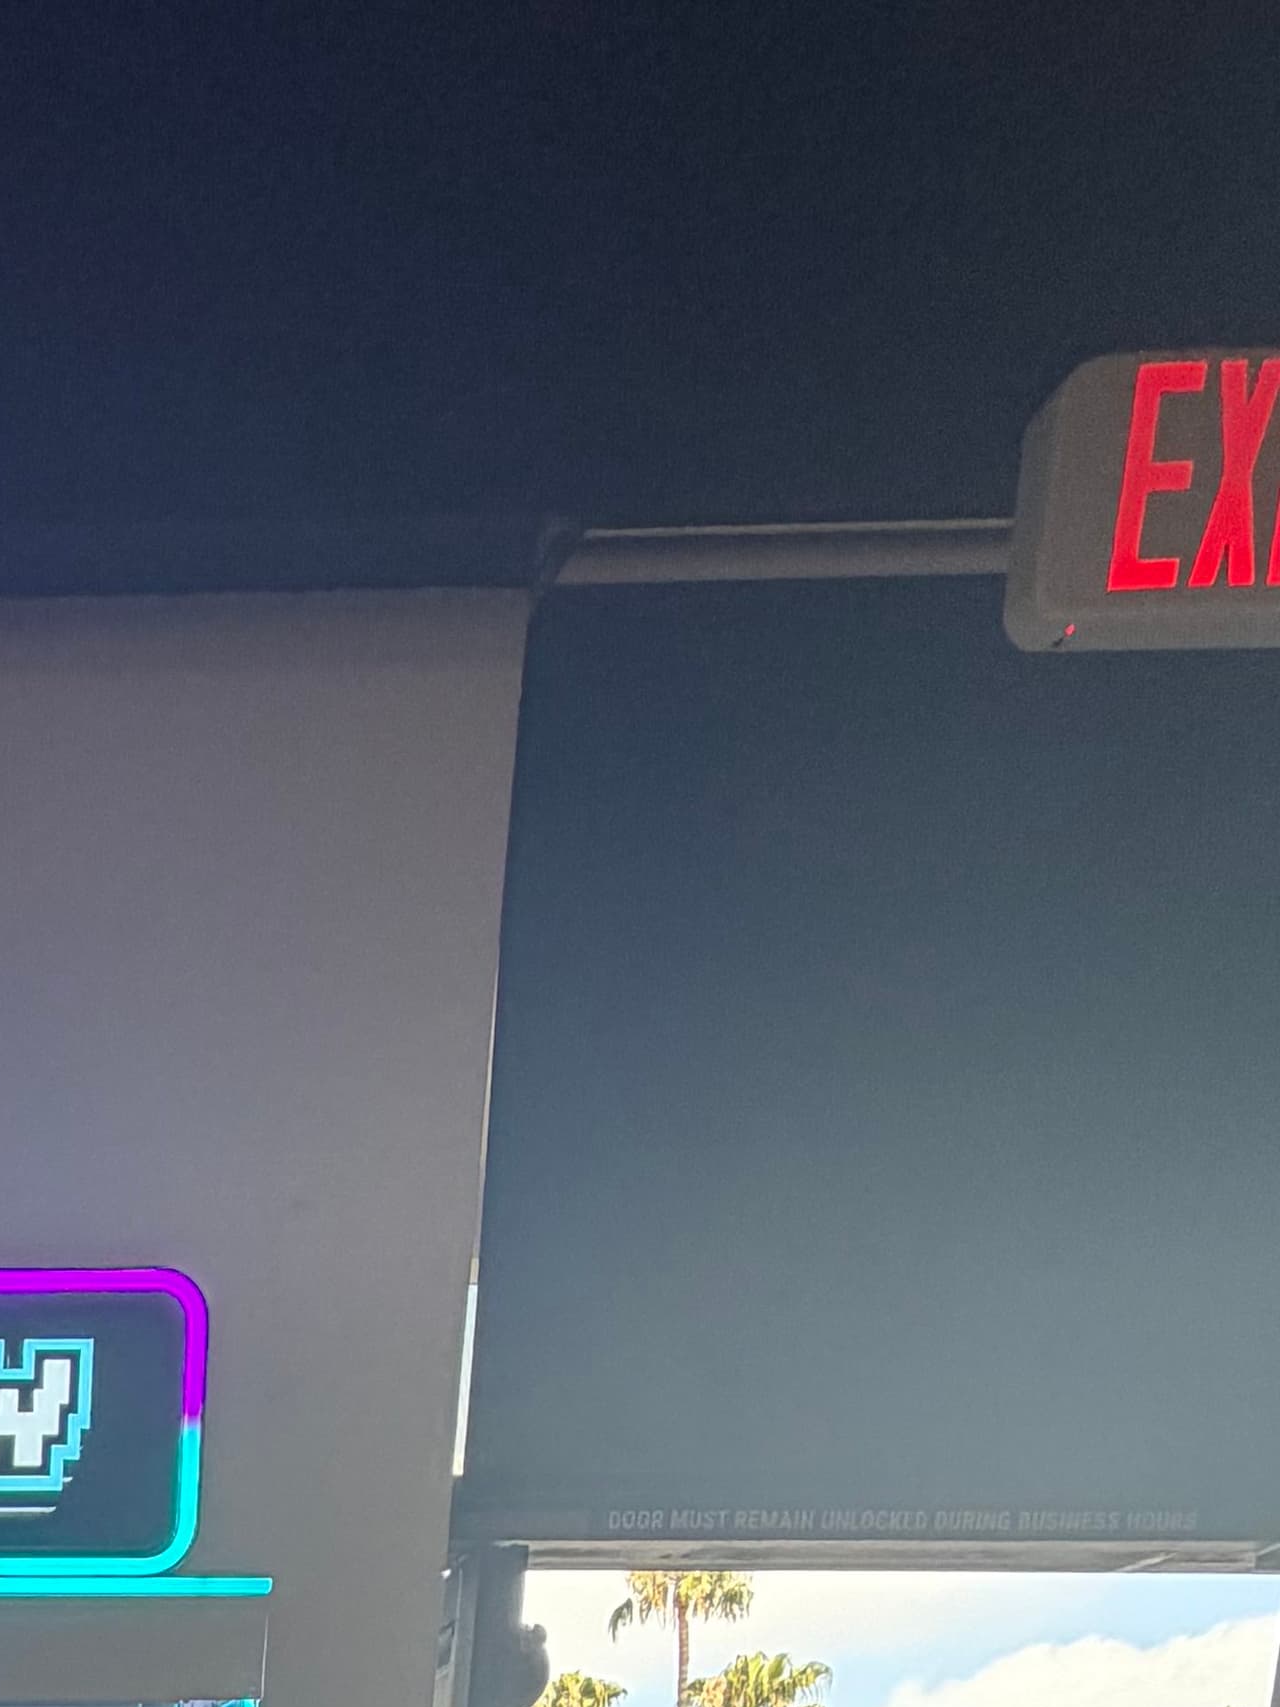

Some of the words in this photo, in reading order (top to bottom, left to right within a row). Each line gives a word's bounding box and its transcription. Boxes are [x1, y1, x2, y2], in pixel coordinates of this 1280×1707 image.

[1107, 358, 1280, 592] EX
[609, 1510, 664, 1530] DOOR
[670, 1510, 731, 1530] MUST
[735, 1510, 813, 1530] REMAIN
[821, 1510, 928, 1530] UNLOCKED
[933, 1510, 1010, 1530] DURING
[1018, 1510, 1121, 1530] BUSINESS
[1126, 1510, 1196, 1530] HOURS
